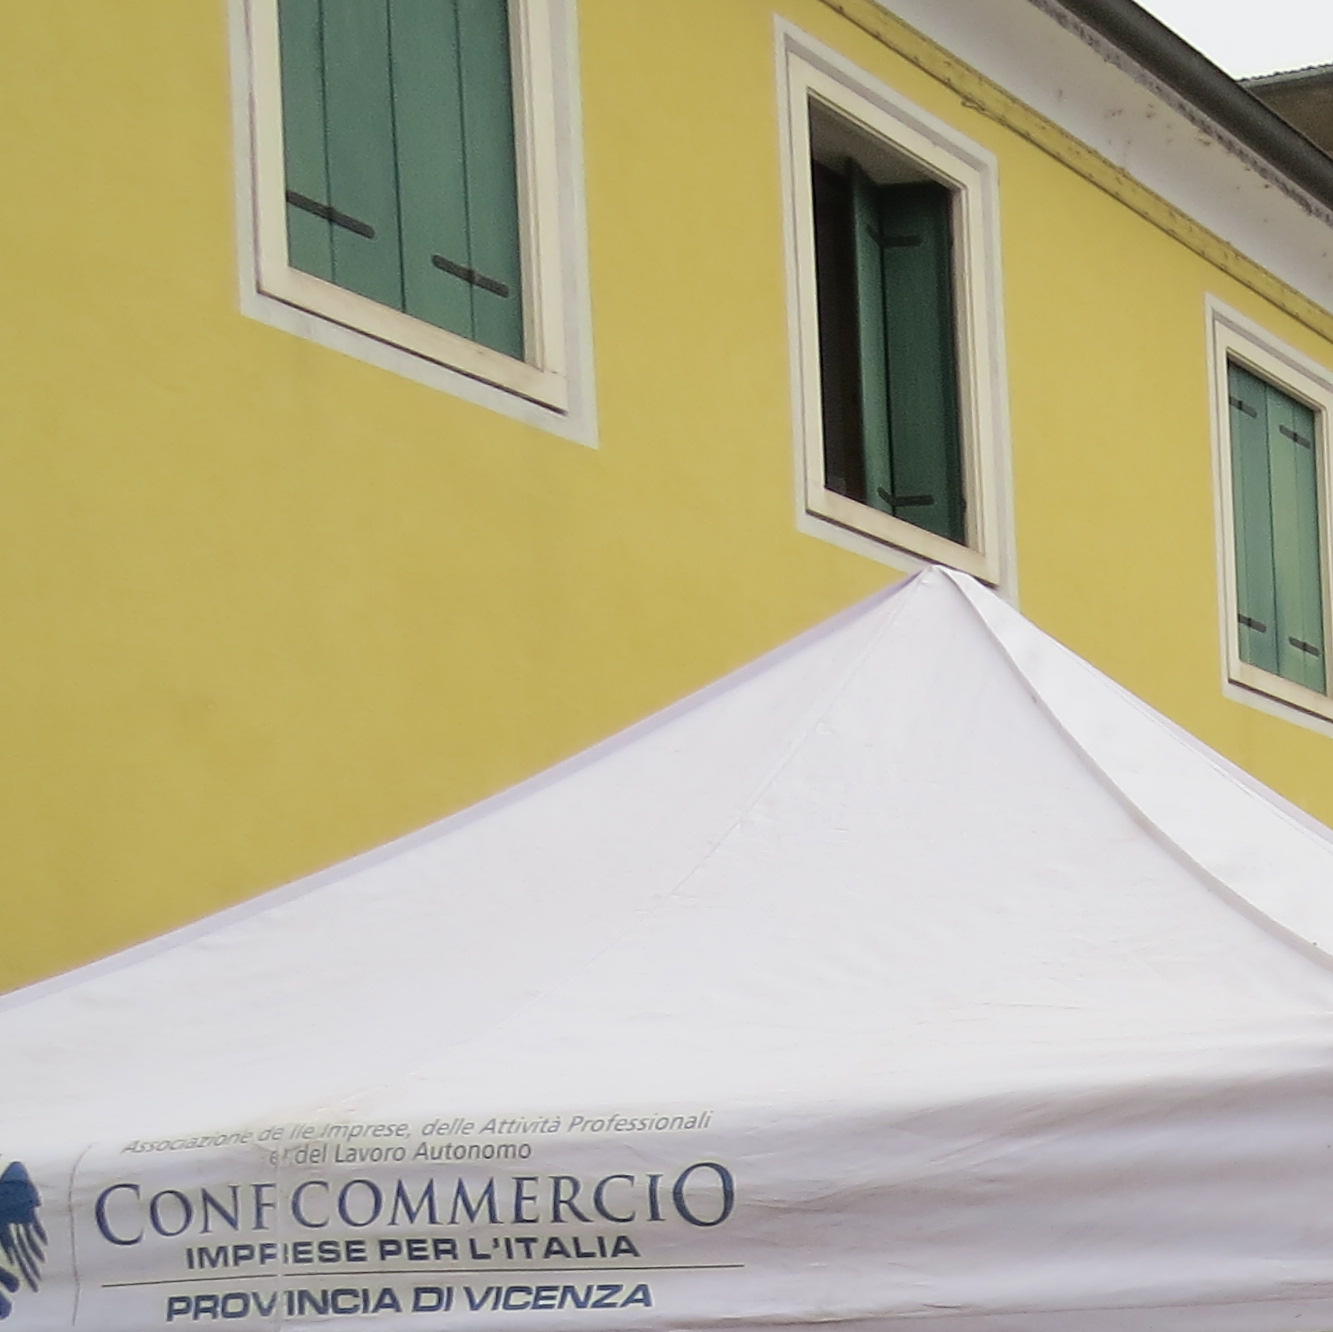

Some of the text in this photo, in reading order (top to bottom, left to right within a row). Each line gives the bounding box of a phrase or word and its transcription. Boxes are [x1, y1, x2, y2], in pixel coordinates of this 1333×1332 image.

[122, 1131, 250, 1154] Associazione
[422, 1117, 475, 1137] delle
[479, 1115, 561, 1135] Attività
[568, 1110, 714, 1135] Professionali
[294, 1145, 326, 1165] del
[335, 1144, 406, 1164] Lavoro
[413, 1142, 532, 1161] Autonomo
[378, 1238, 458, 1262] PER
[469, 1235, 641, 1260] L'ITALIA
[166, 1284, 652, 1322] PROVINCIA DI VICENZA
